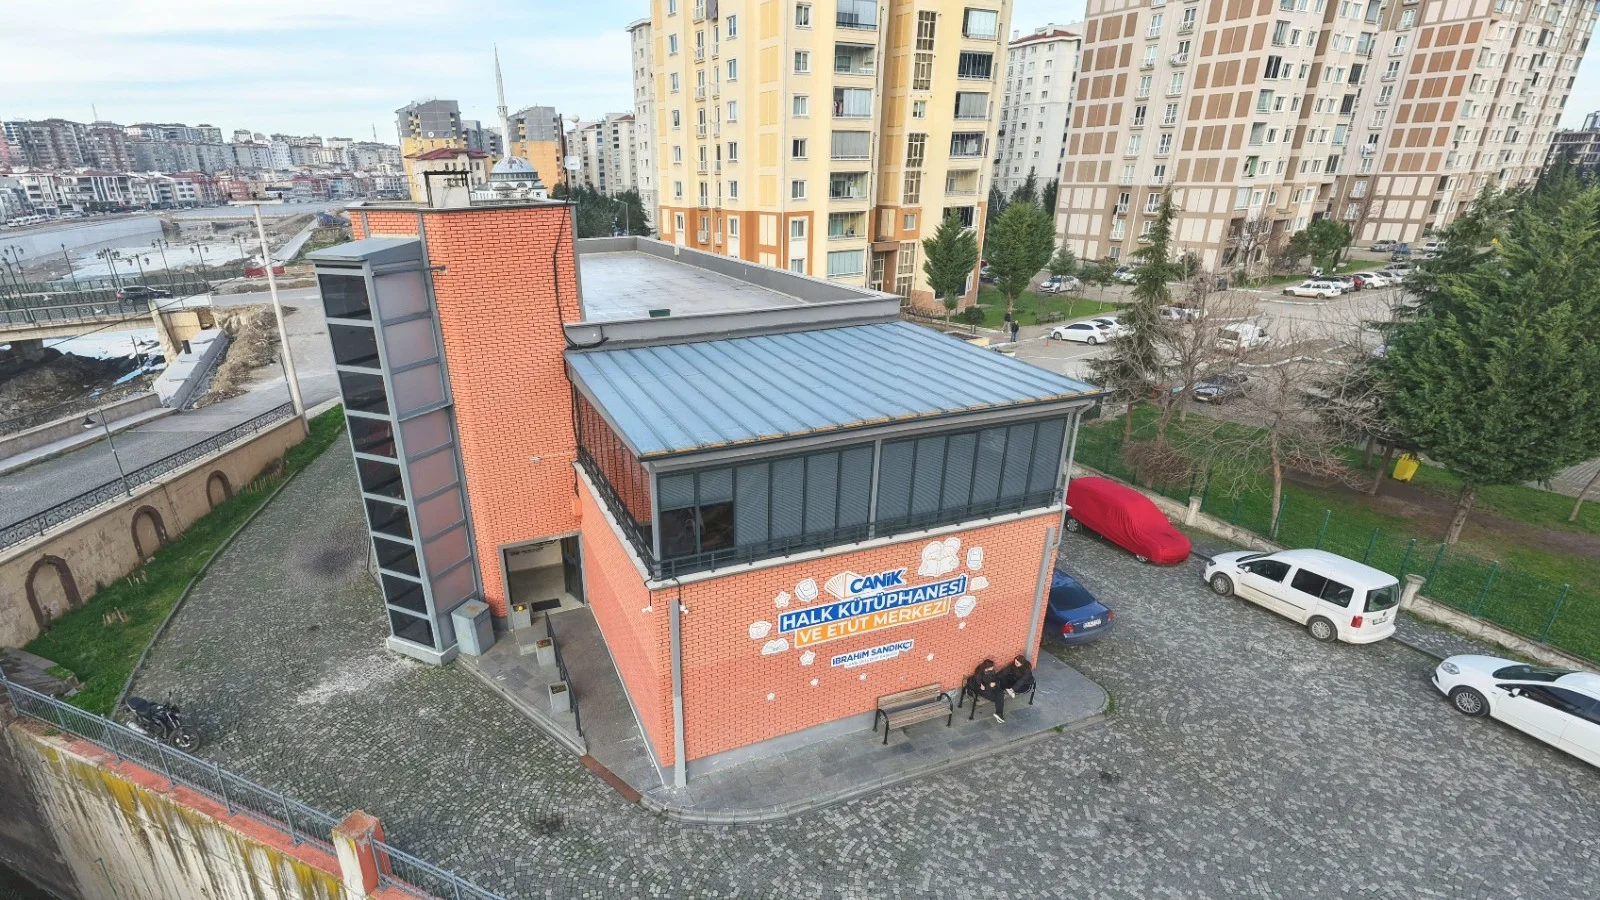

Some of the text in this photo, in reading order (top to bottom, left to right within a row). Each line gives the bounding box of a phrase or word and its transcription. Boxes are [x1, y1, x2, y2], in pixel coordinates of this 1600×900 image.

[782, 576, 964, 630] HALK KÜTÜPHANESİ
[799, 627, 823, 643] VE
